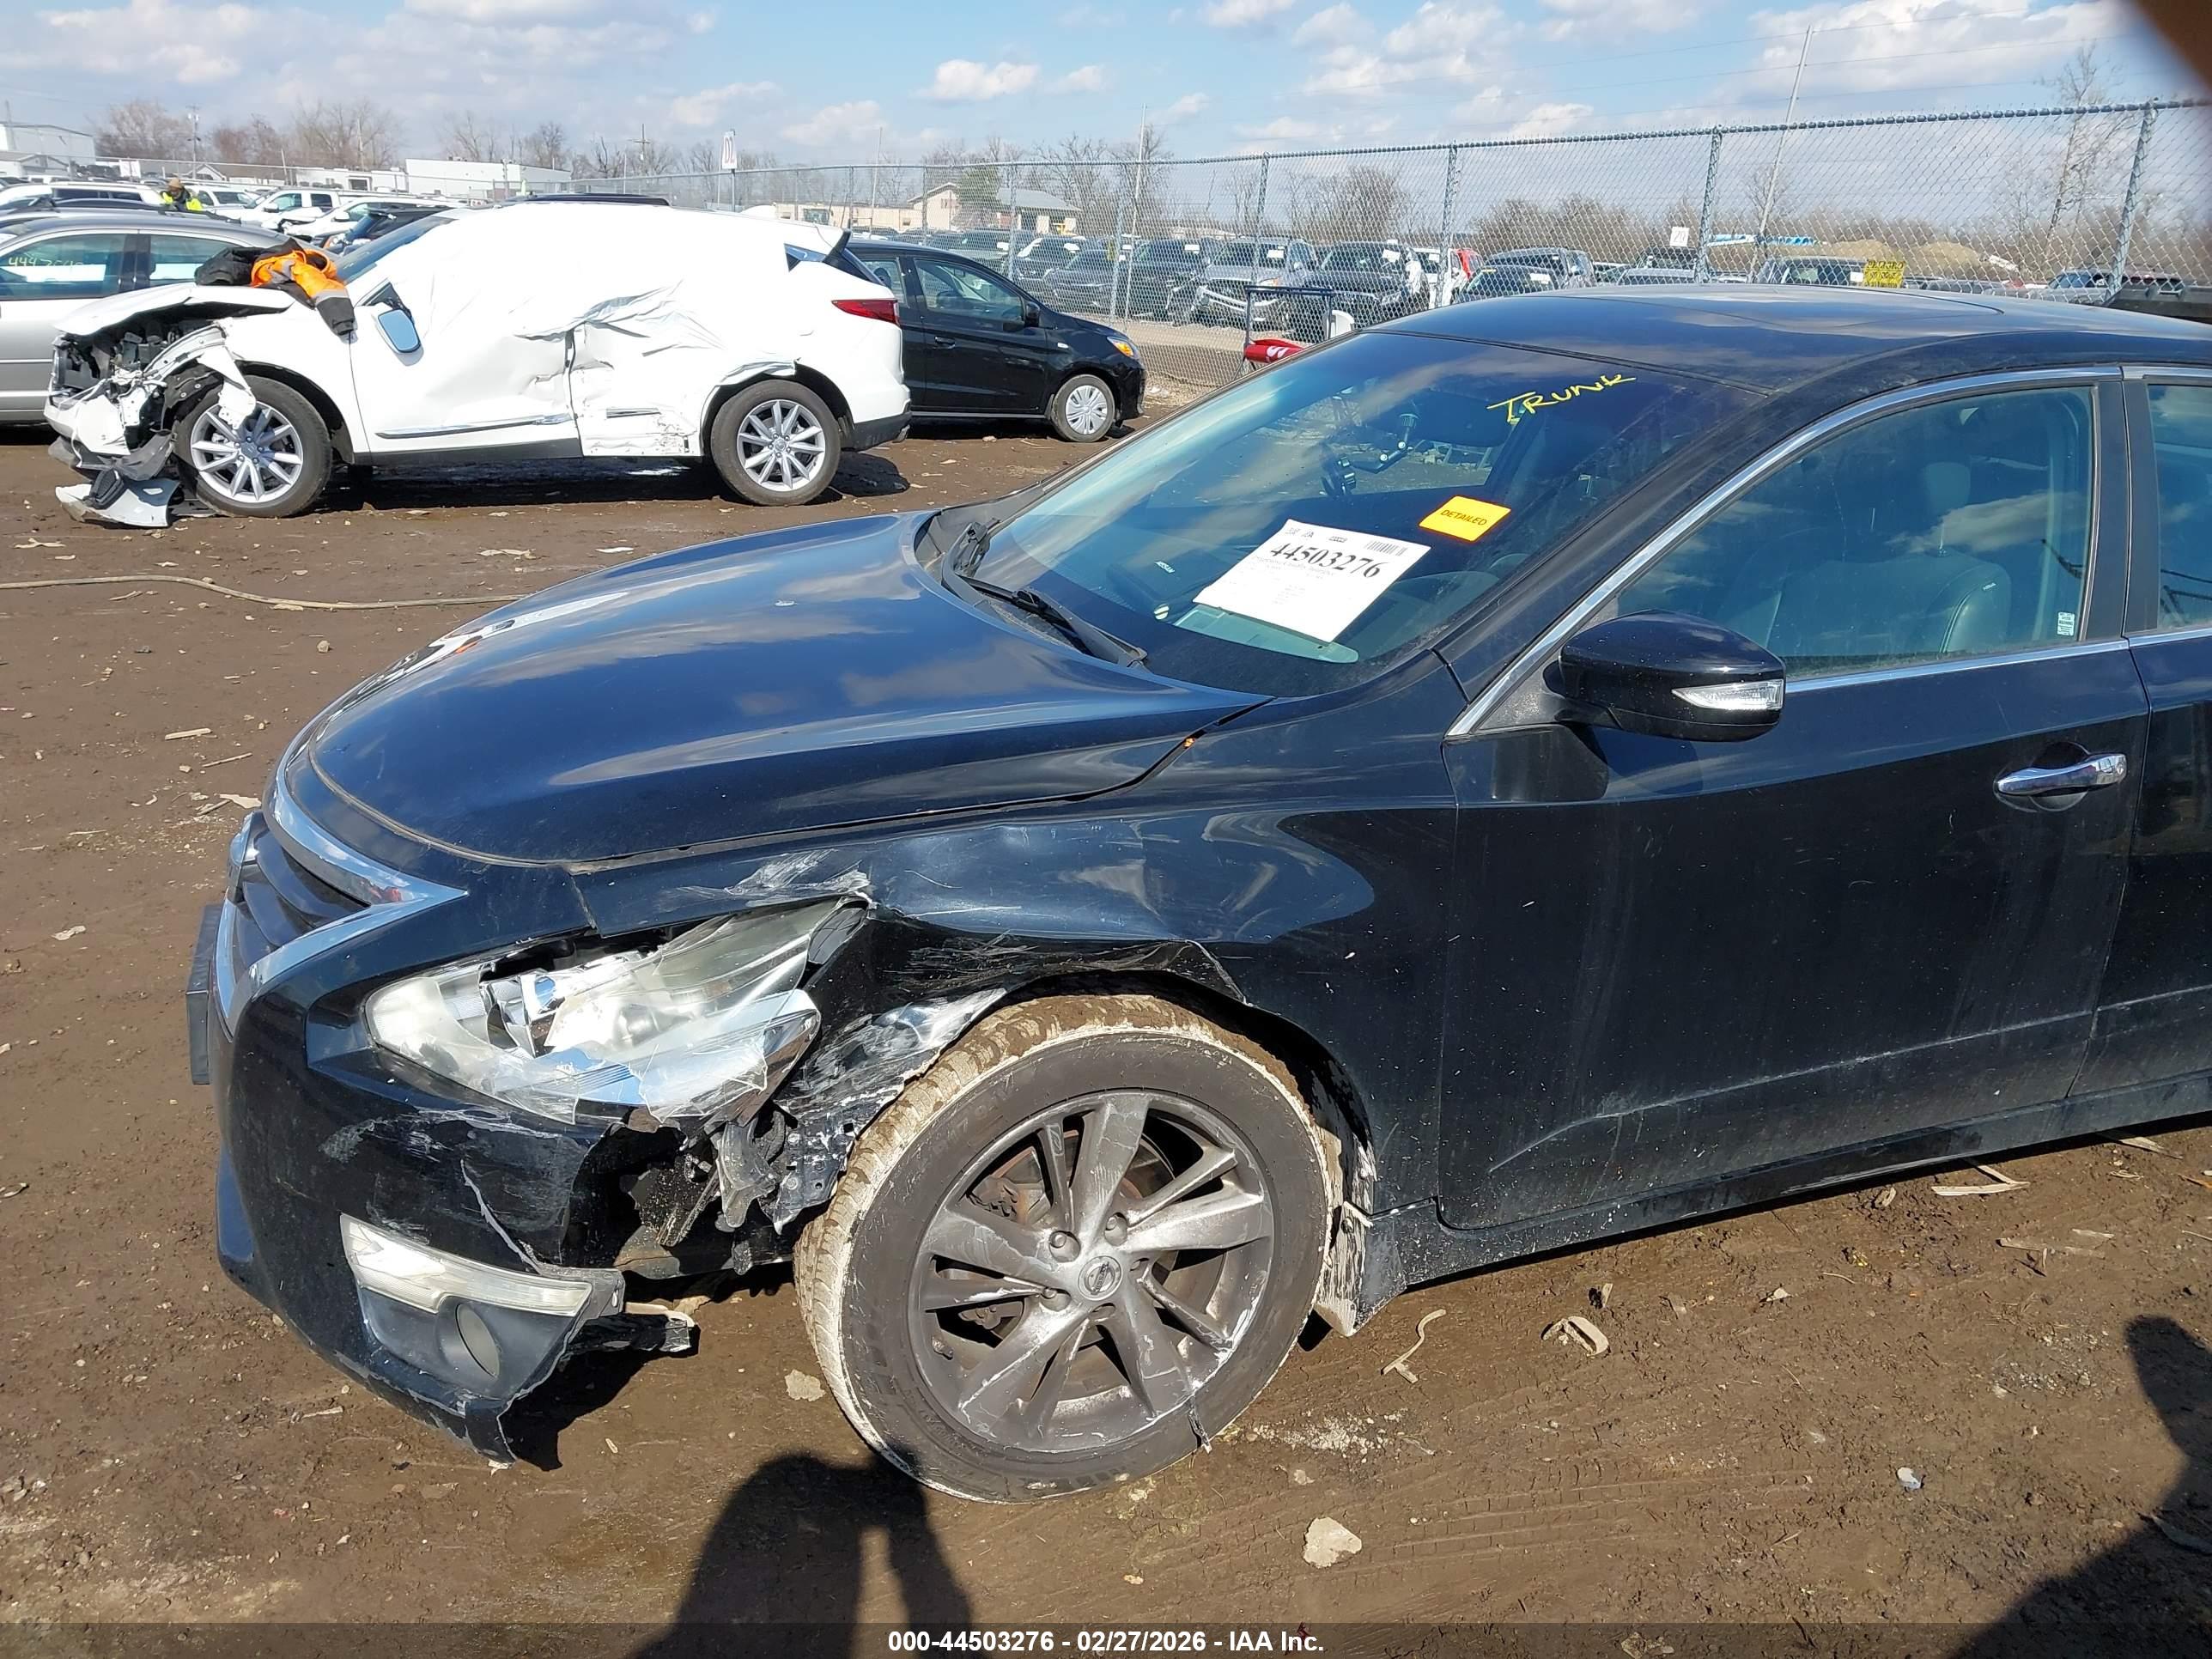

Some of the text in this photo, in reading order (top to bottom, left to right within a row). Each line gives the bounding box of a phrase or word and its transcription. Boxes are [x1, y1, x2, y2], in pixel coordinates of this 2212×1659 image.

[1486, 374, 1637, 423] TRUNK
[1440, 509, 1487, 526] DETAILED
[1270, 543, 1389, 578] 44503276
